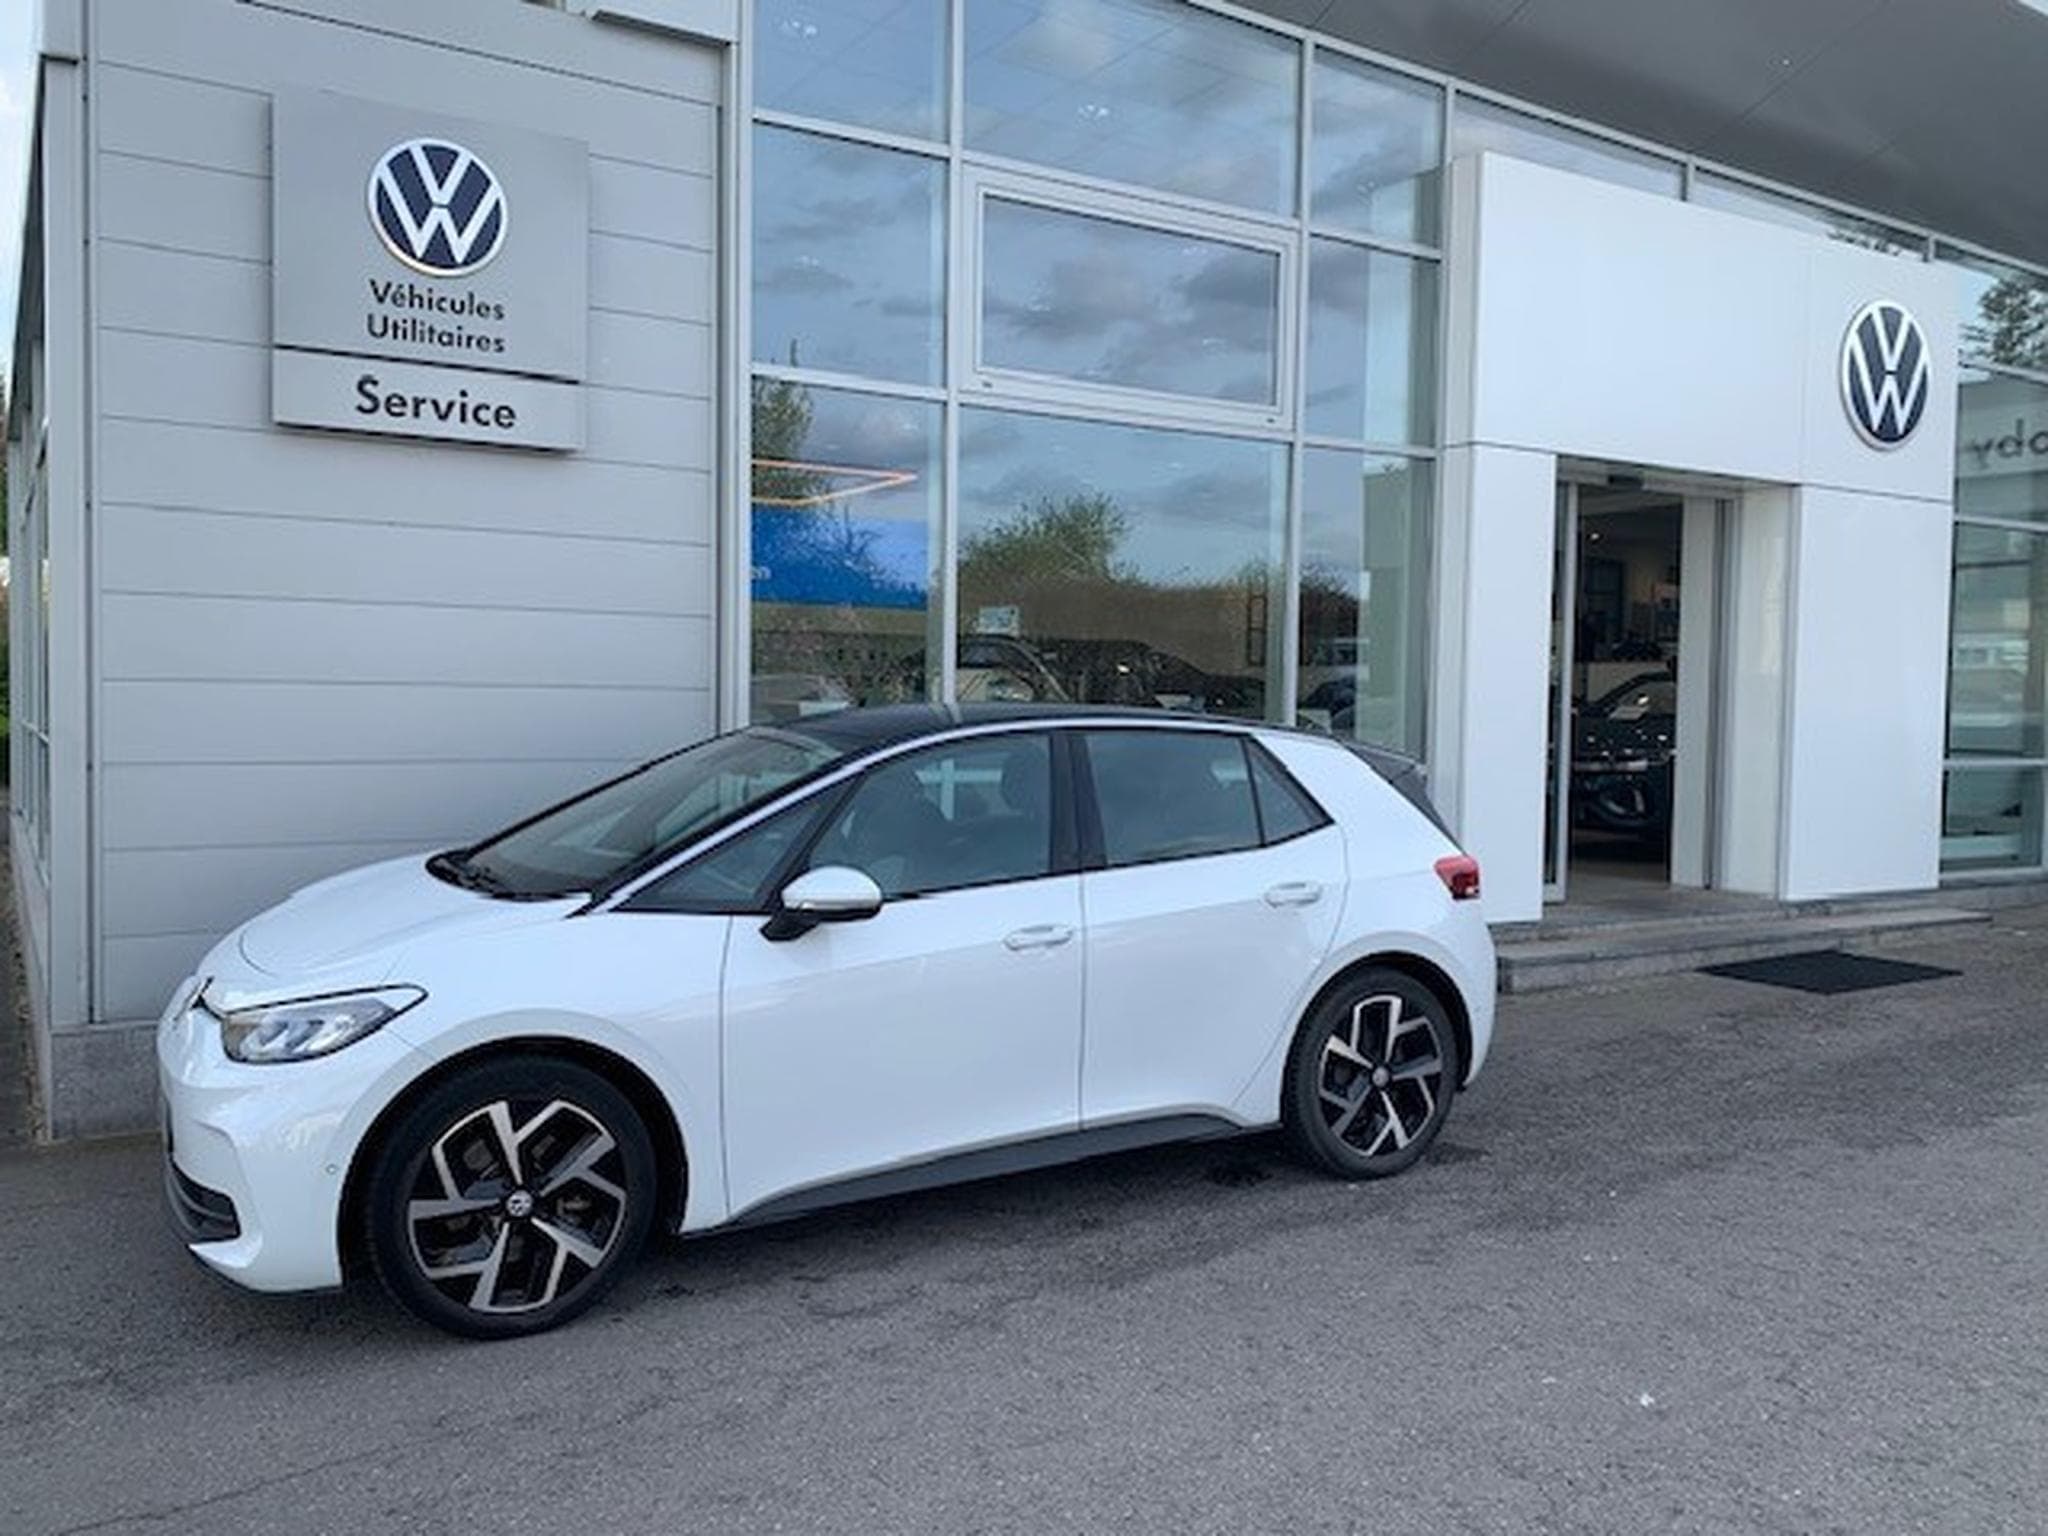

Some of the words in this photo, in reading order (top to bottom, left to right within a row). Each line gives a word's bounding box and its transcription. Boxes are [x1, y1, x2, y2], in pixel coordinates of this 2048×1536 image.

[368, 139, 507, 276] VW
[370, 279, 505, 321] Véhicules
[367, 314, 506, 353] Utilitaires
[355, 374, 517, 429] Service
[1842, 301, 1931, 449] VW
